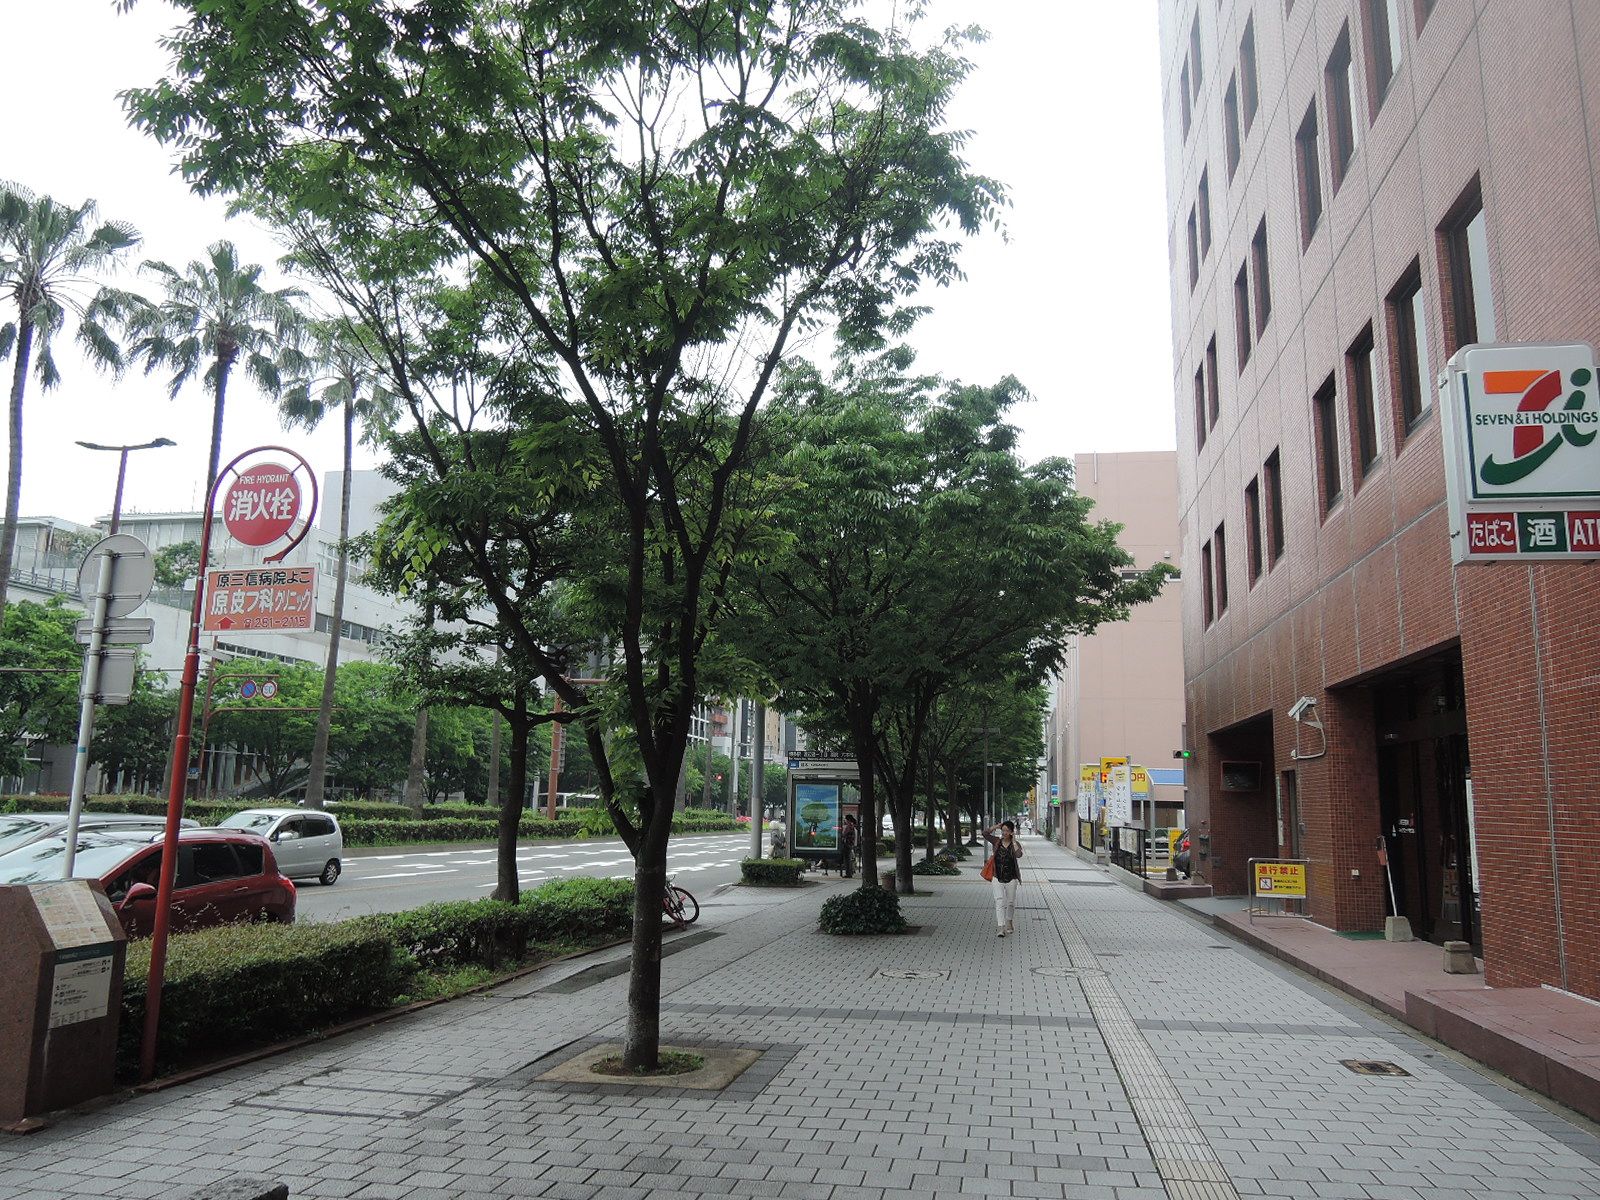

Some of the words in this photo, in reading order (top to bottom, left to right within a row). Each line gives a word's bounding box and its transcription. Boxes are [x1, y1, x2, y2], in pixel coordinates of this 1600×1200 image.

[1532, 410, 1599, 425] HOLDINGS
[239, 475, 256, 485] FIRE
[256, 473, 290, 484] HYDRANT
[228, 487, 296, 521] 消火栓
[1470, 519, 1515, 547] たばこ
[1526, 518, 1556, 547] 酒
[1573, 517, 1600, 546] AT
[216, 571, 310, 588] 原三信病院よこ
[1258, 866, 1299, 875] 通行禁止
